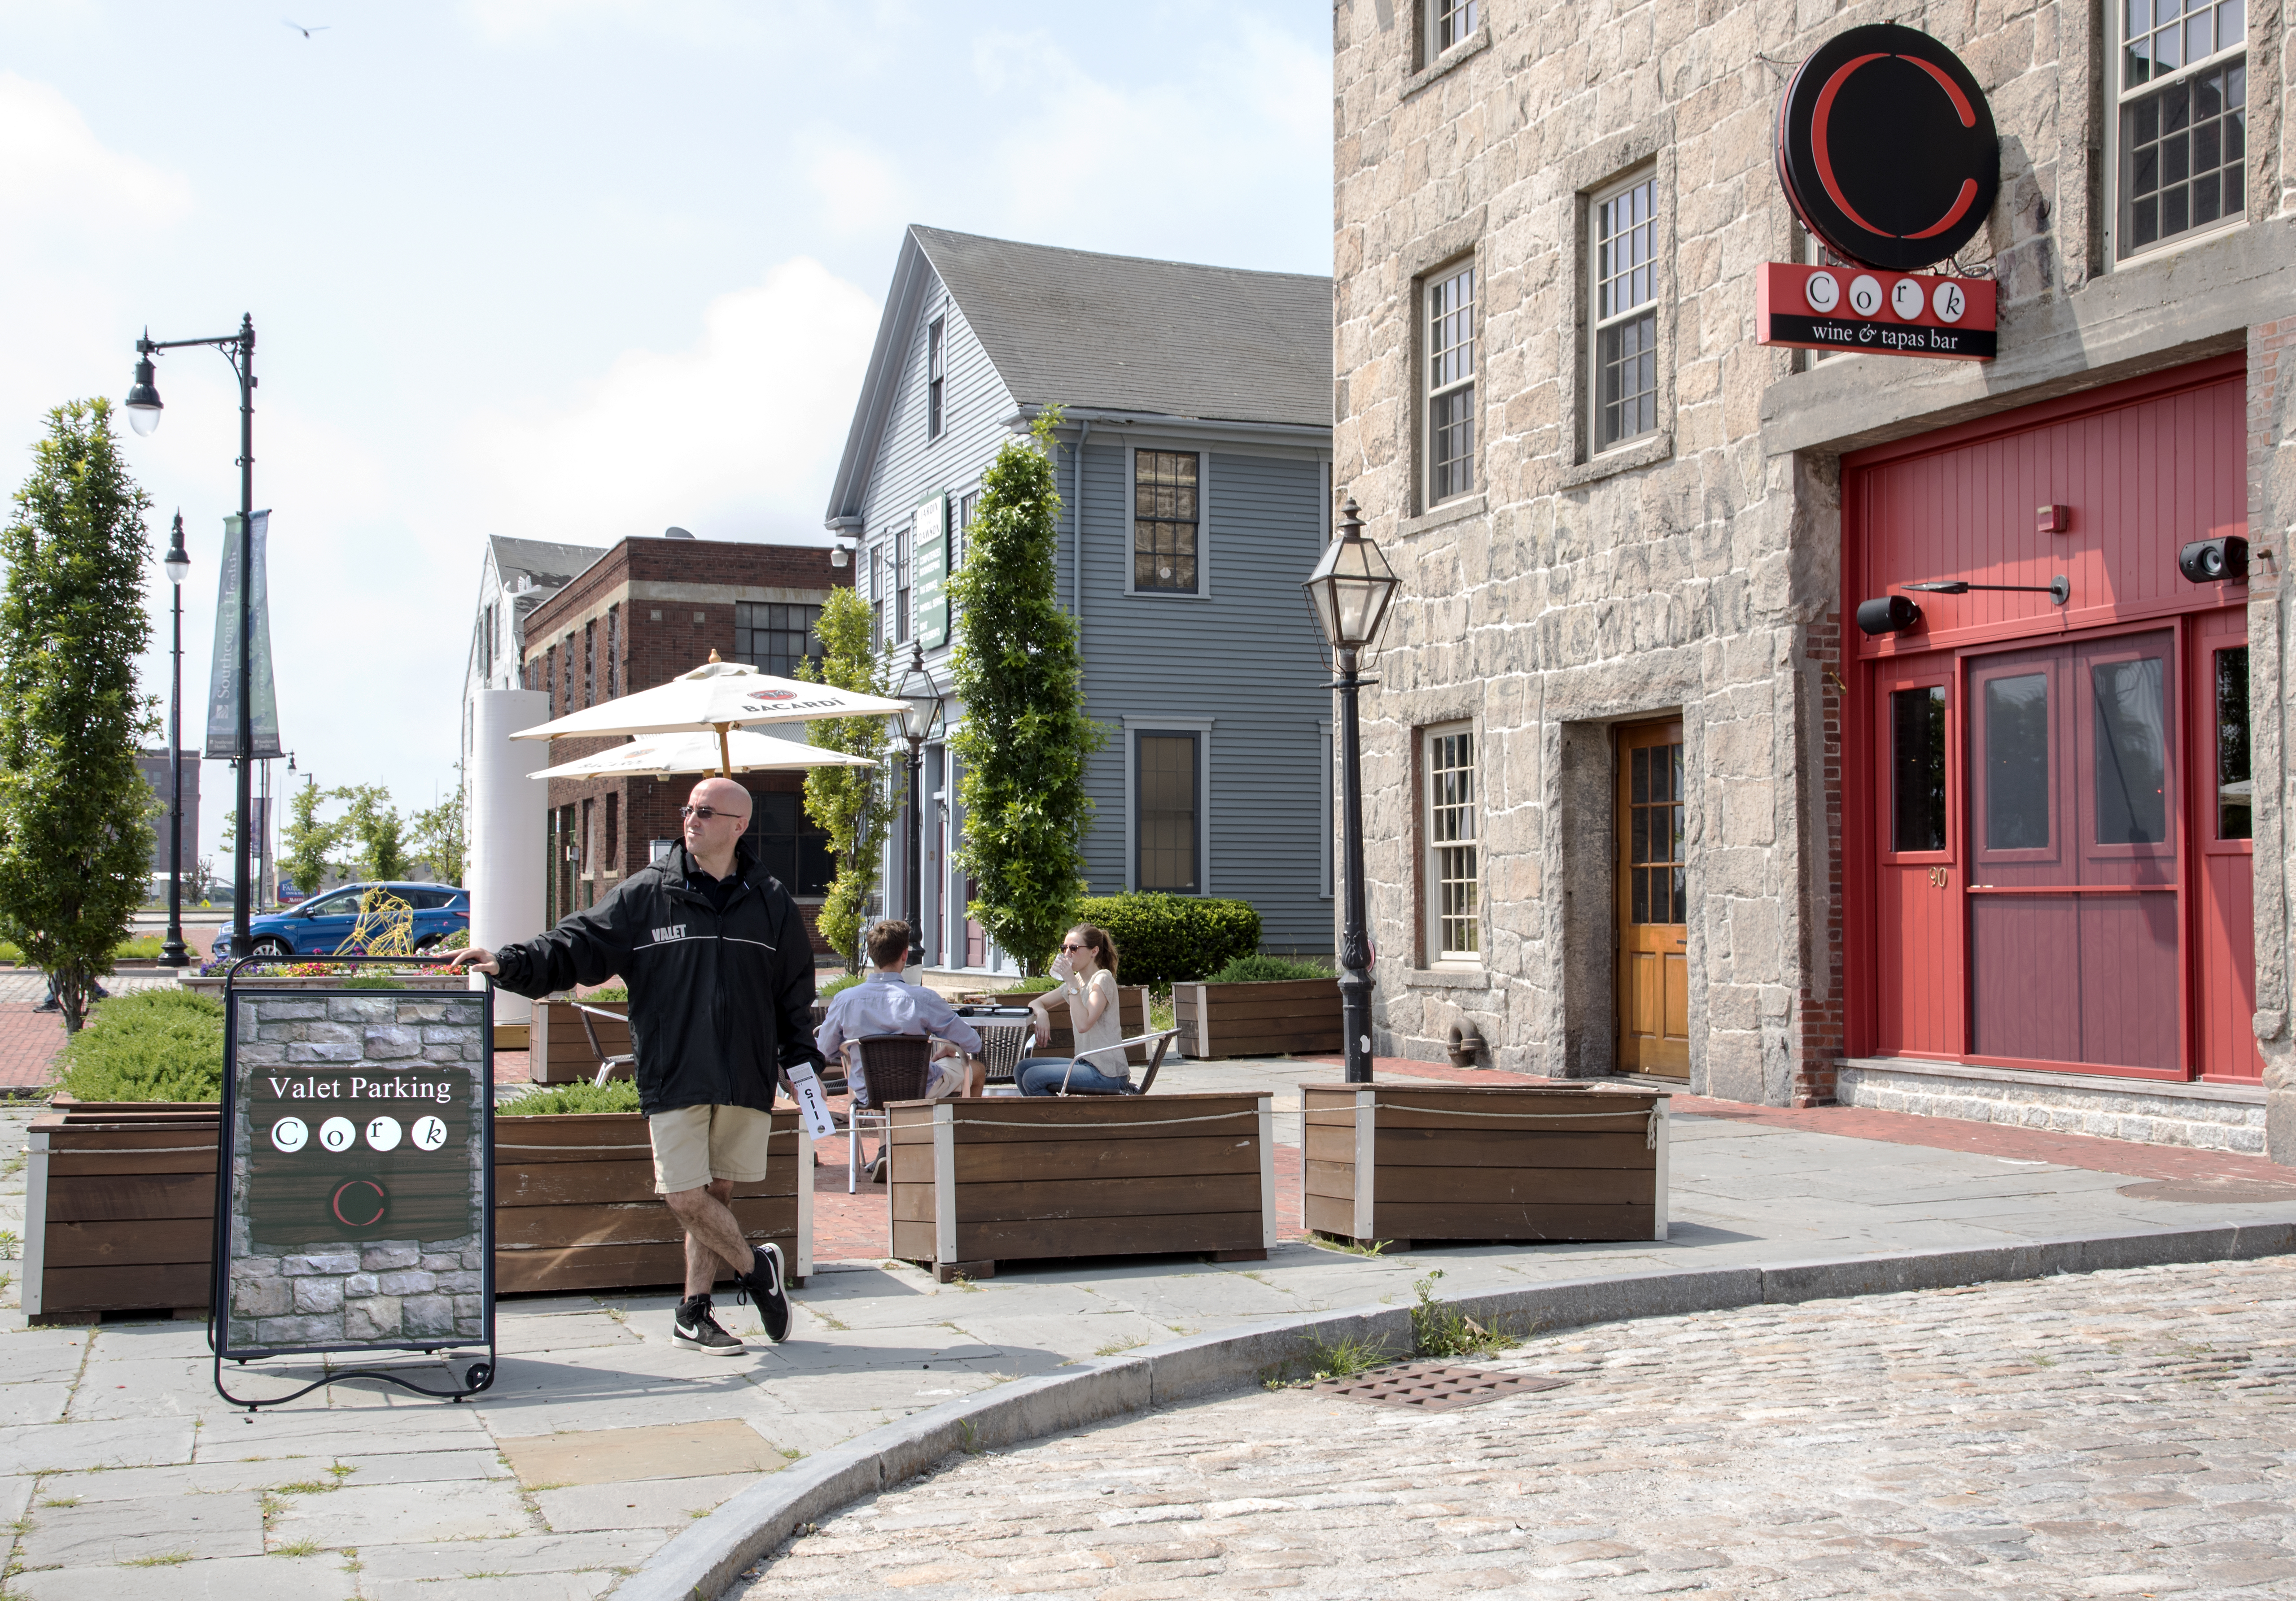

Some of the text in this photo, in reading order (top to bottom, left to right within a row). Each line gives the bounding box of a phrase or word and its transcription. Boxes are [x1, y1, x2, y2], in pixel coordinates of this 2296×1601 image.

[1810, 276, 1960, 315] Cork
[1812, 323, 1958, 350] wine & tapas bar
[920, 502, 938, 519] JARDIN
[919, 524, 939, 542] DAWSON
[925, 579, 938, 593] SERVICE
[932, 594, 945, 608] SERVICE
[217, 551, 237, 698] Southcoast Health
[1929, 867, 1947, 887] 90
[652, 924, 687, 942] VALET
[268, 1076, 451, 1104] Valet Parking
[276, 1119, 442, 1146] Cork
